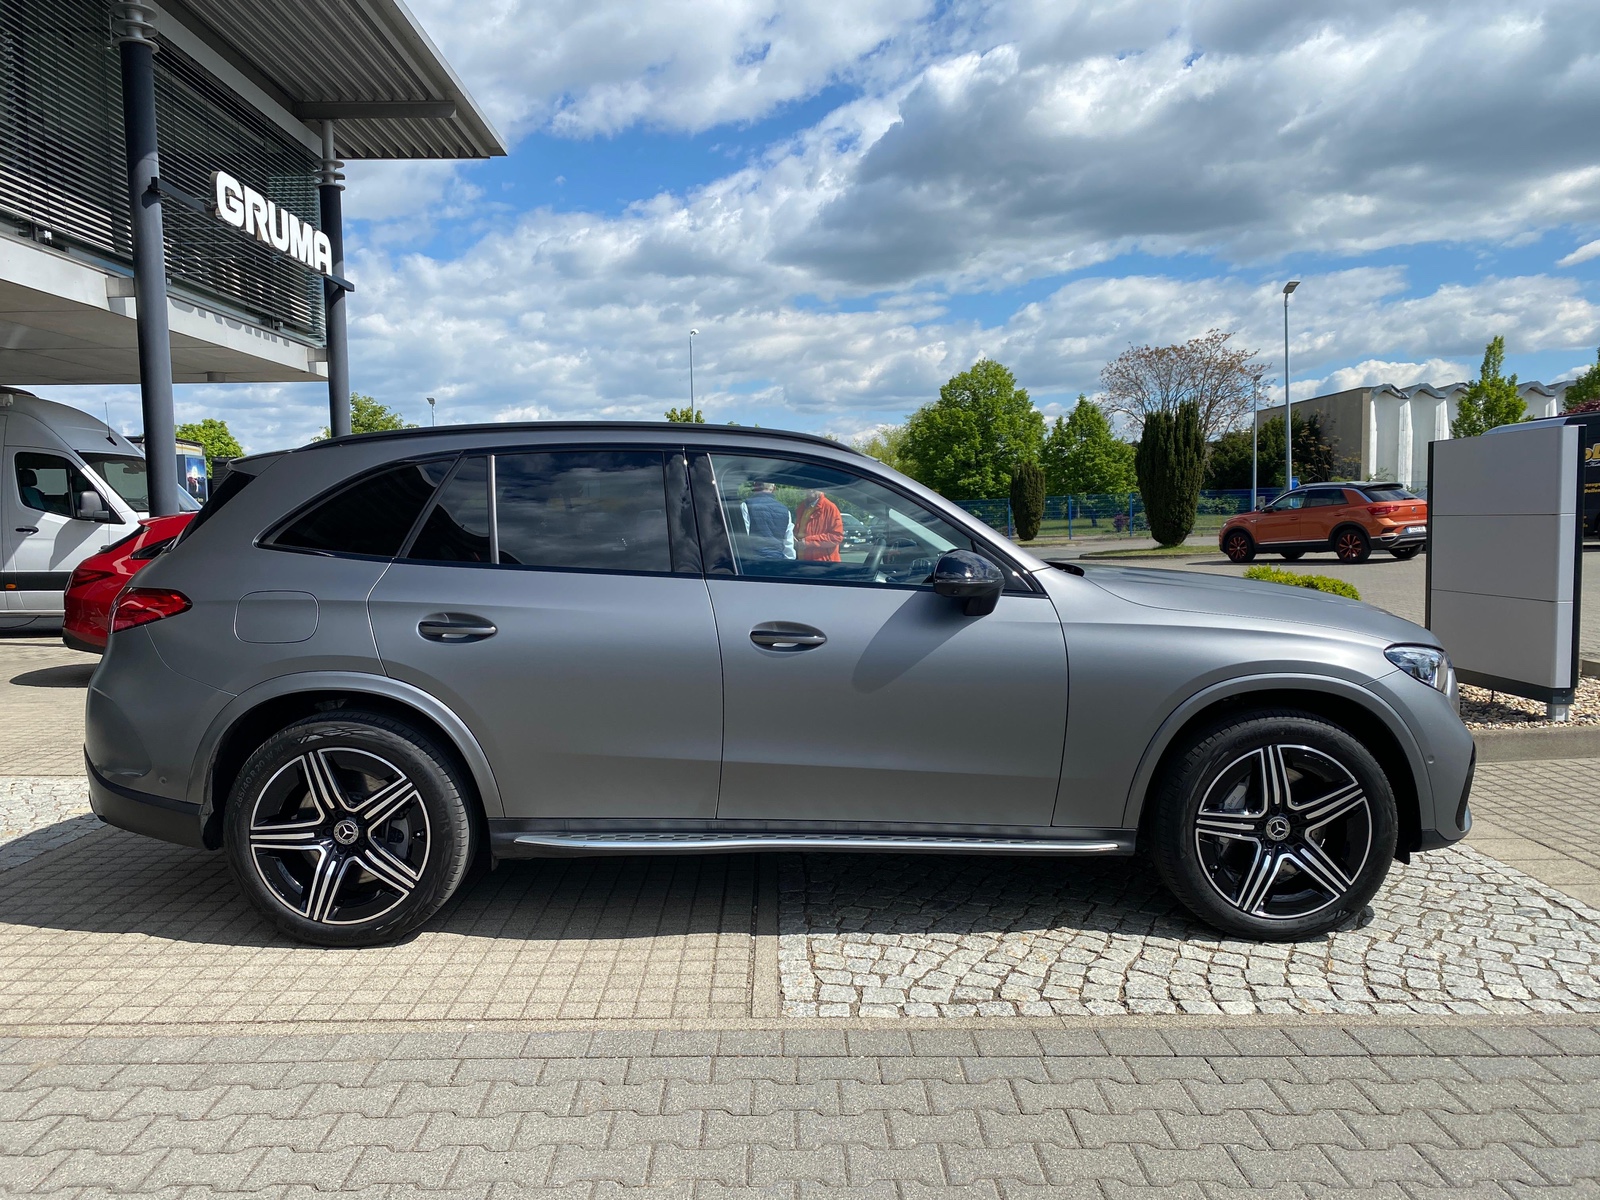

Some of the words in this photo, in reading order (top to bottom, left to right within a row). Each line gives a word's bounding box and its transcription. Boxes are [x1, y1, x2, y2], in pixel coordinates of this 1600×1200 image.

[214, 170, 333, 276] GRUMA
[234, 776, 253, 808] 285/40
[249, 769, 257, 778] R
[254, 759, 266, 772] 20
